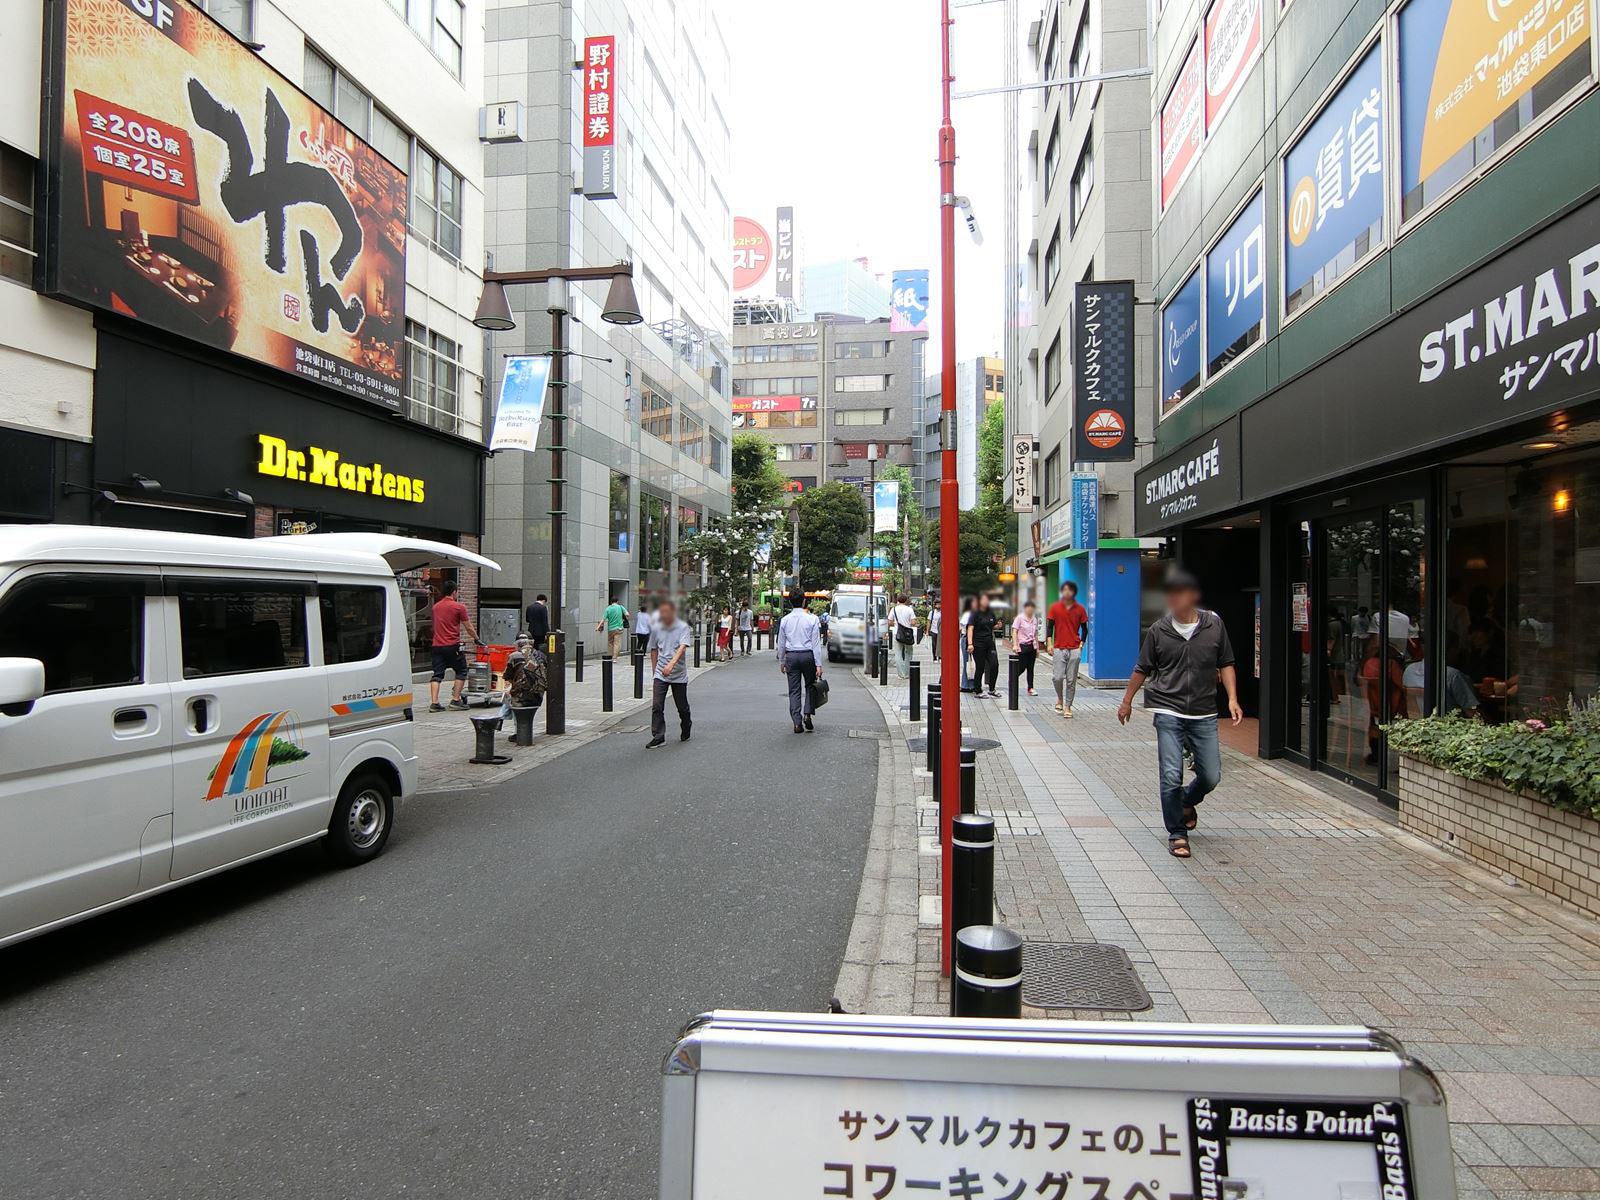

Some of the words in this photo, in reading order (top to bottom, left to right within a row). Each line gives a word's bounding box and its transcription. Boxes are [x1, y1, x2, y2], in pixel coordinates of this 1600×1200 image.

[1497, 4, 1585, 101] 池袋東口店
[588, 43, 610, 139] 野村證券
[88, 112, 181, 156] 全208席
[93, 145, 186, 187] 個室25室
[602, 150, 610, 190] NOMURA
[295, 346, 337, 373] 池袋東口店
[1083, 294, 1106, 401] サンマルクカフェ
[752, 400, 780, 410] ガスト
[801, 398, 816, 409] 7F
[1015, 456, 1026, 497] てけてけ
[1146, 465, 1186, 505] ST.MARC
[1187, 438, 1219, 486] CAFÉ
[1081, 482, 1089, 549] 池袋チケットセンター
[1160, 494, 1197, 519] サンマルクカフェ
[230, 814, 245, 826] LIFE
[245, 801, 294, 821] CORPORATION
[235, 785, 289, 813] UNIMAT
[838, 1110, 1182, 1157] サンマルクカフェの上
[1228, 1106, 1299, 1132] Basis
[1303, 1109, 1375, 1135] Point
